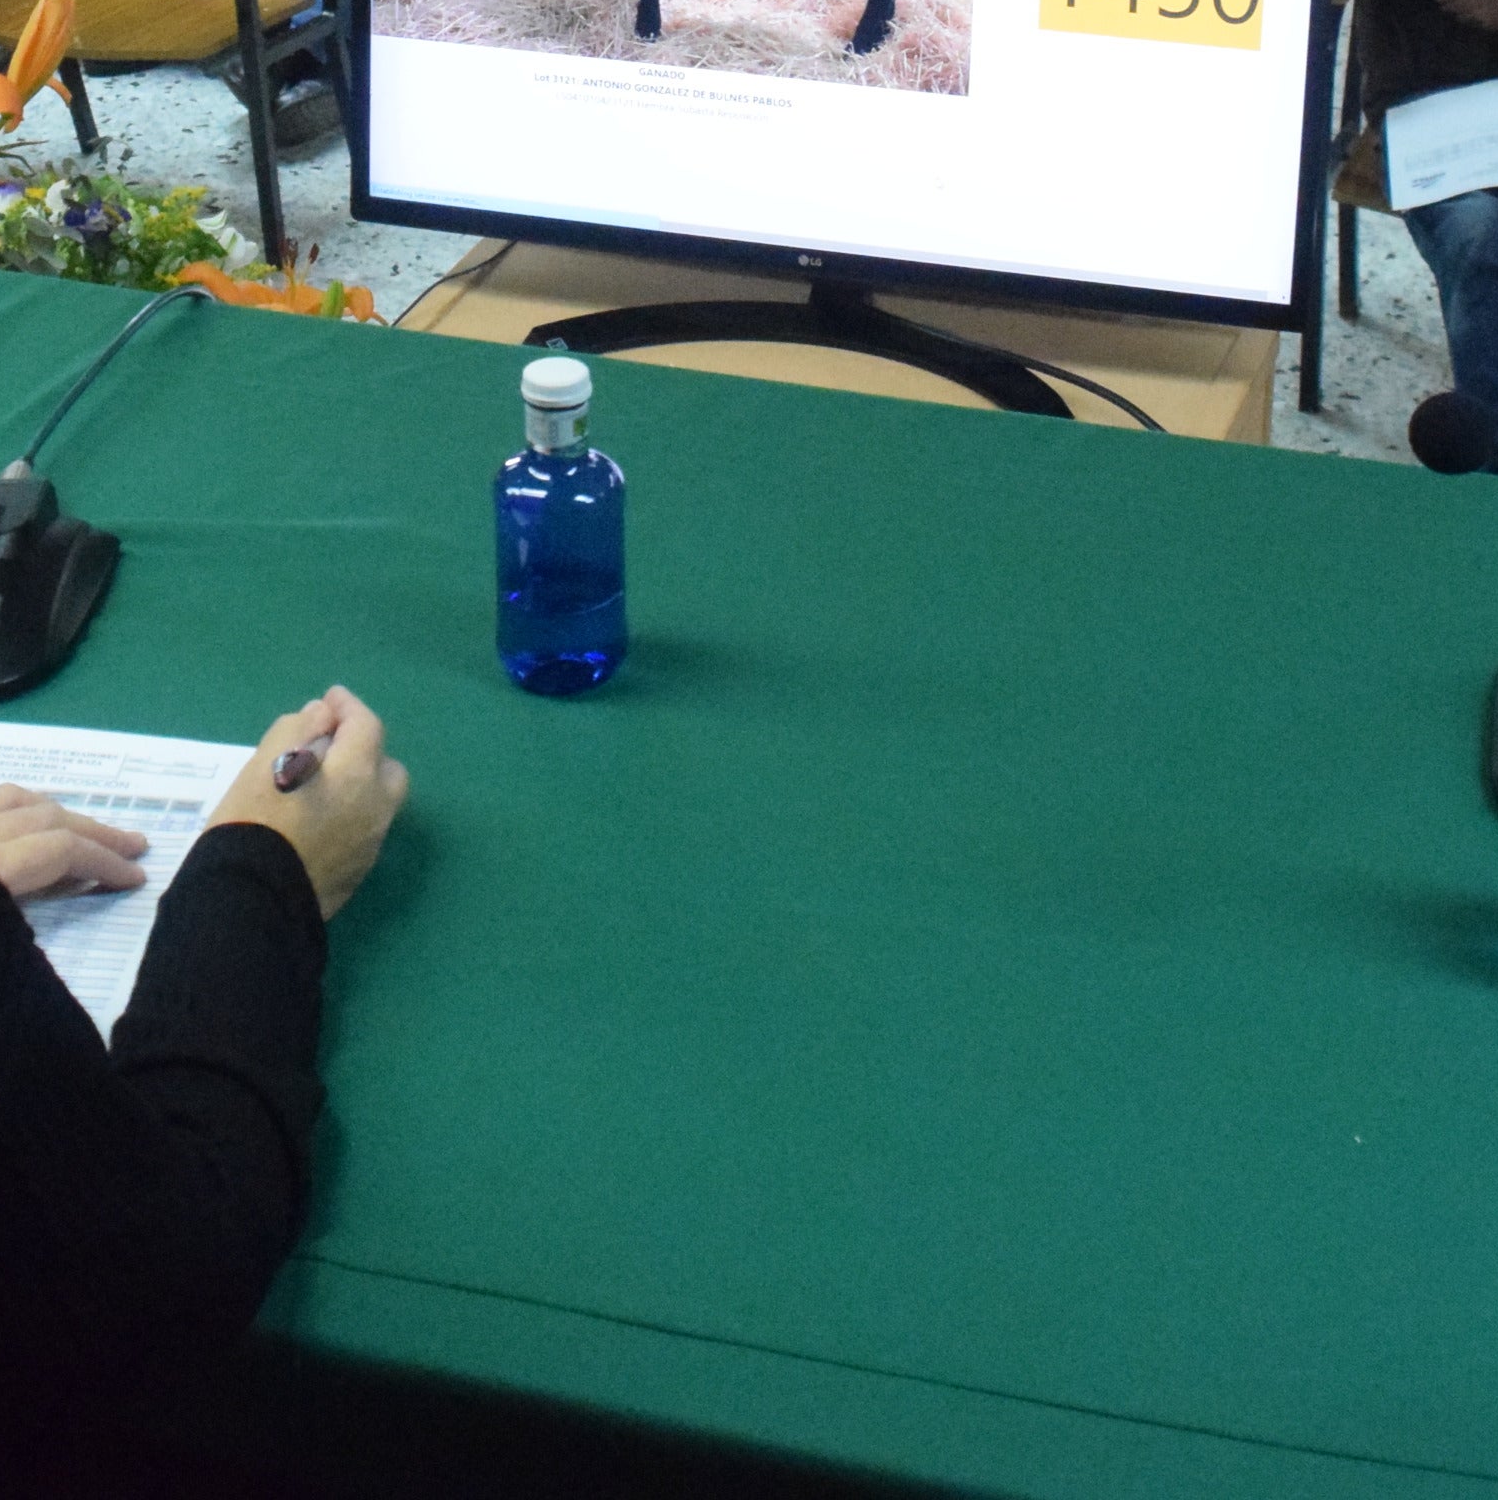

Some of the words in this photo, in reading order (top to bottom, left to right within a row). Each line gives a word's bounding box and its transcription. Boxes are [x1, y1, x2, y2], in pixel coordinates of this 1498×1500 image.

[639, 66, 686, 81] GANADO
[534, 72, 550, 83] Lot
[582, 78, 632, 92] ANTONIO
[634, 83, 690, 97] GONZALEZ
[692, 89, 707, 100] DE
[709, 91, 750, 104] BULNES
[752, 96, 793, 109] PABLOS
[810, 257, 822, 267] LG
[49, 773, 131, 789] REPOSICIÓN
